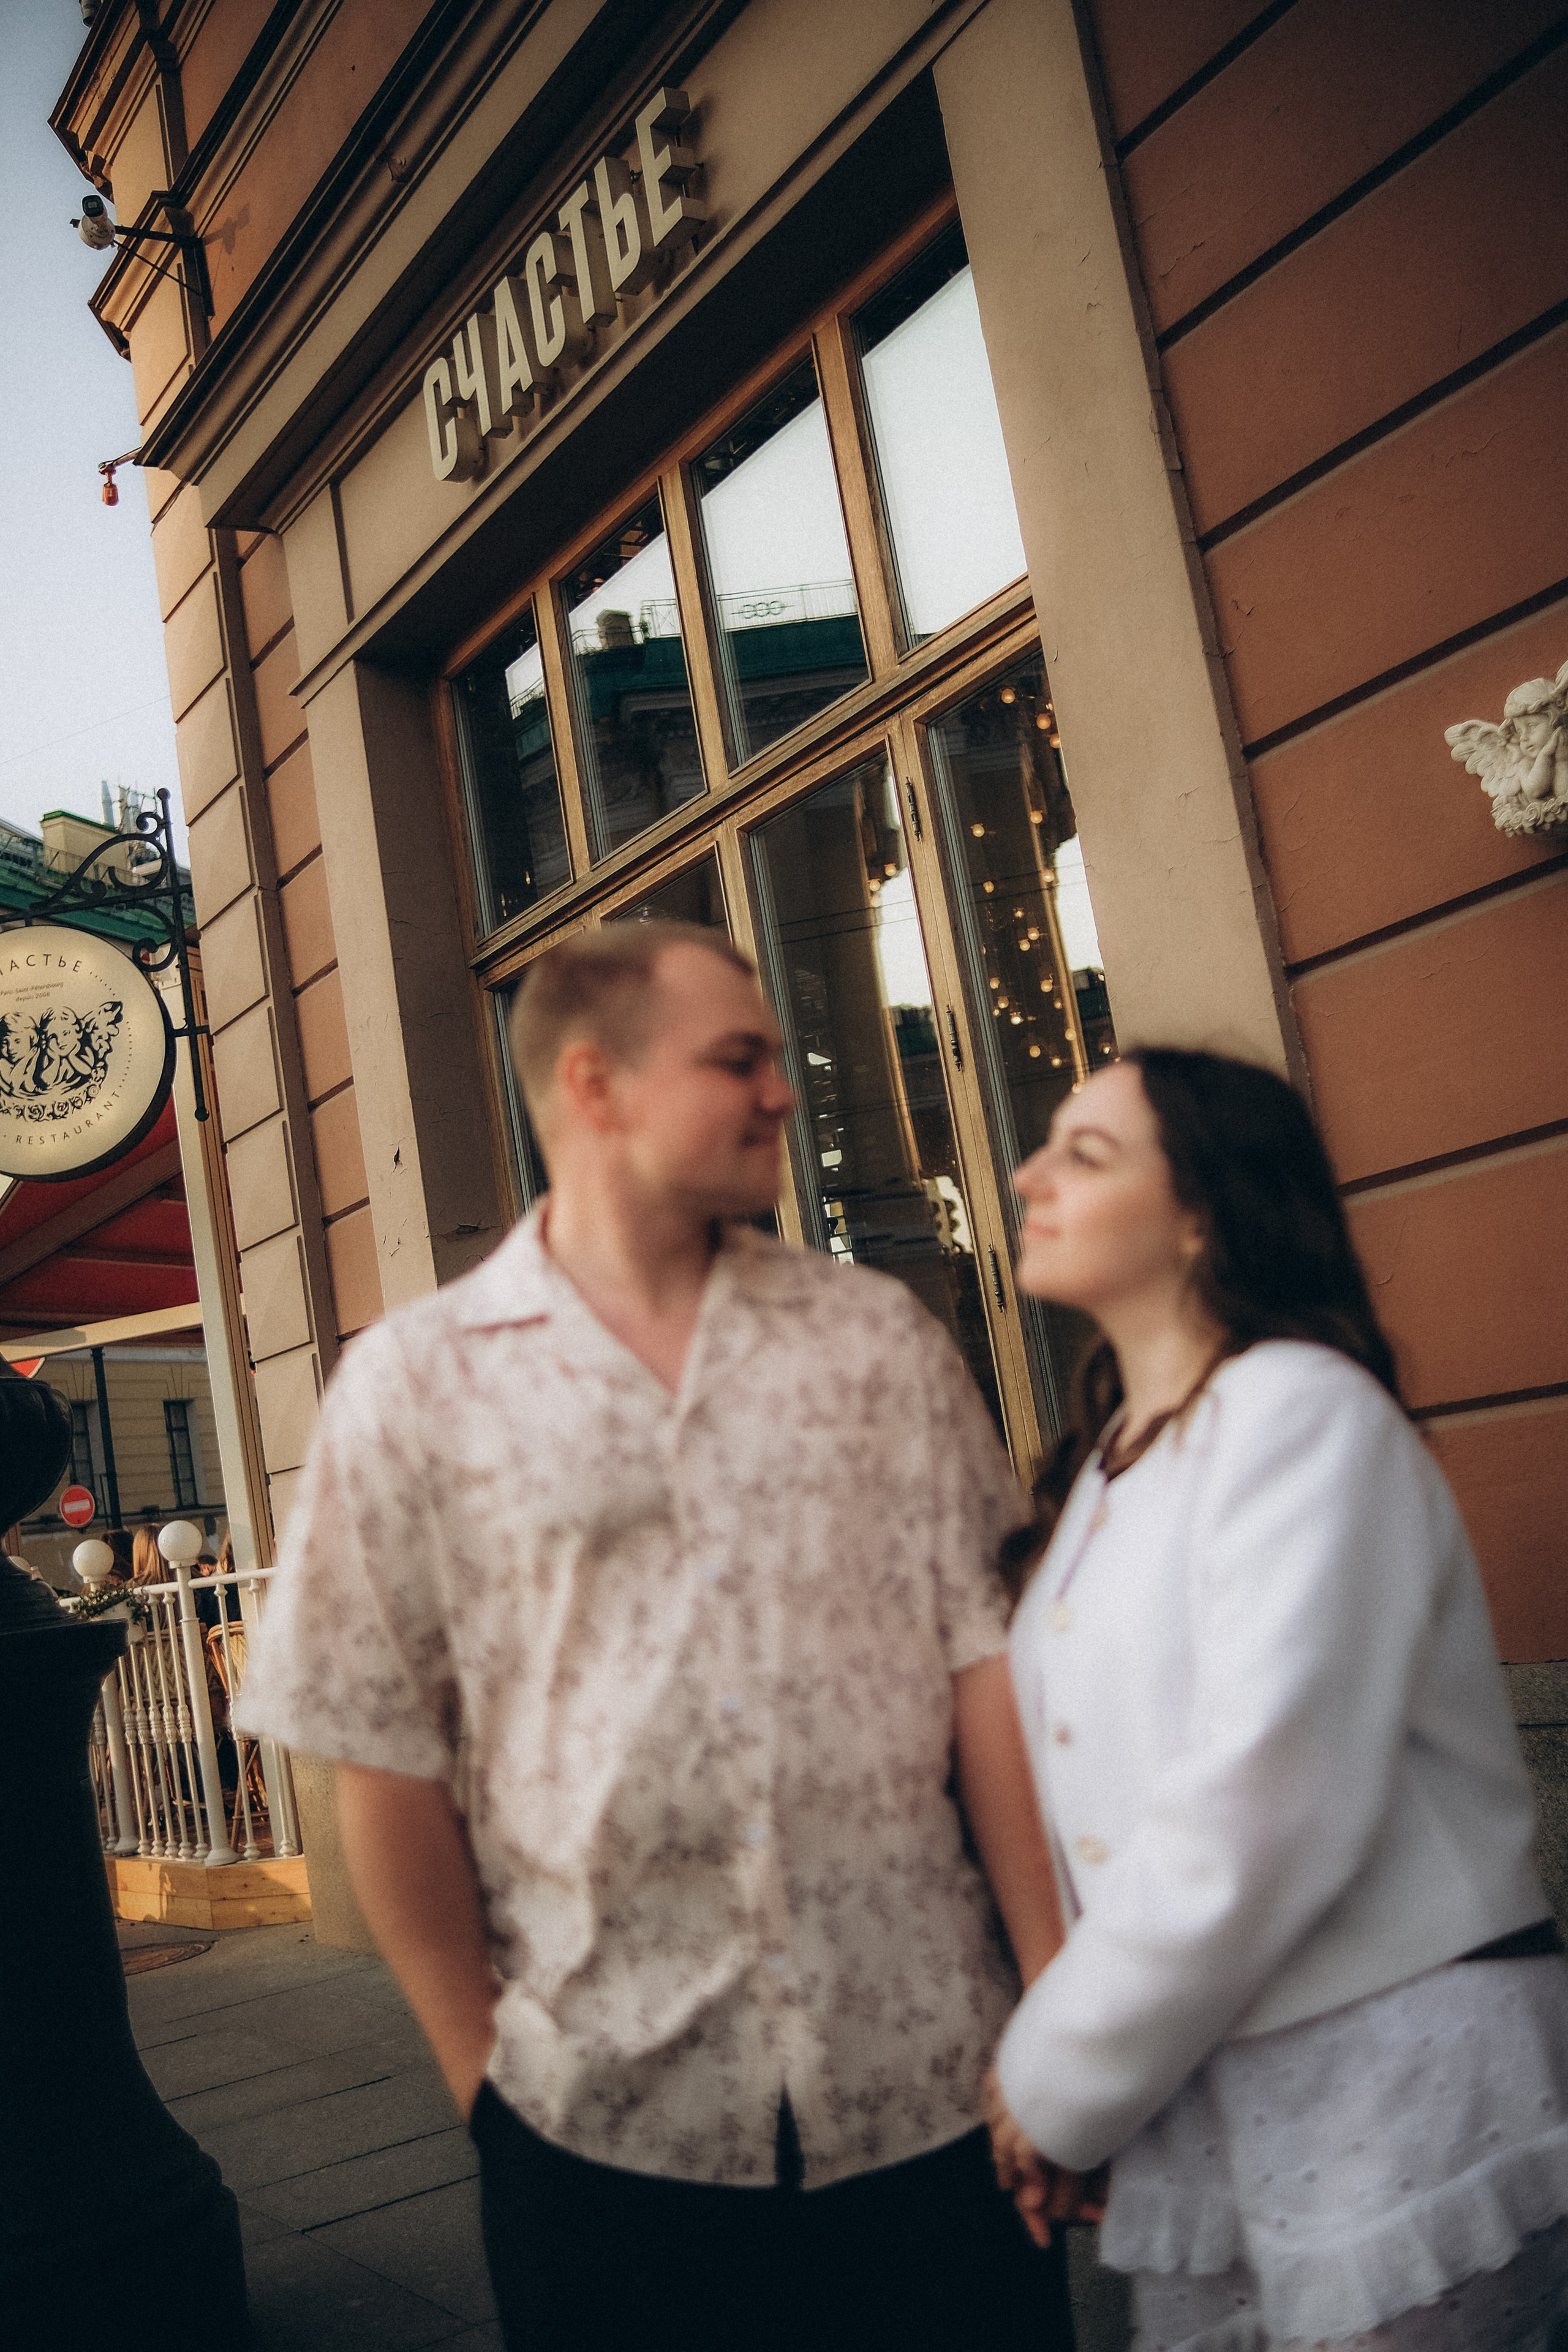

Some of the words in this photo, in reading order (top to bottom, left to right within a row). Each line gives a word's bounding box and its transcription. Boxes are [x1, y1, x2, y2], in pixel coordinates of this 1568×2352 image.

[423, 86, 684, 481] СЧАСТЬЕ
[0, 954, 82, 975] АСТЬЕ
[16, 1090, 120, 1145] RESTAURANT
